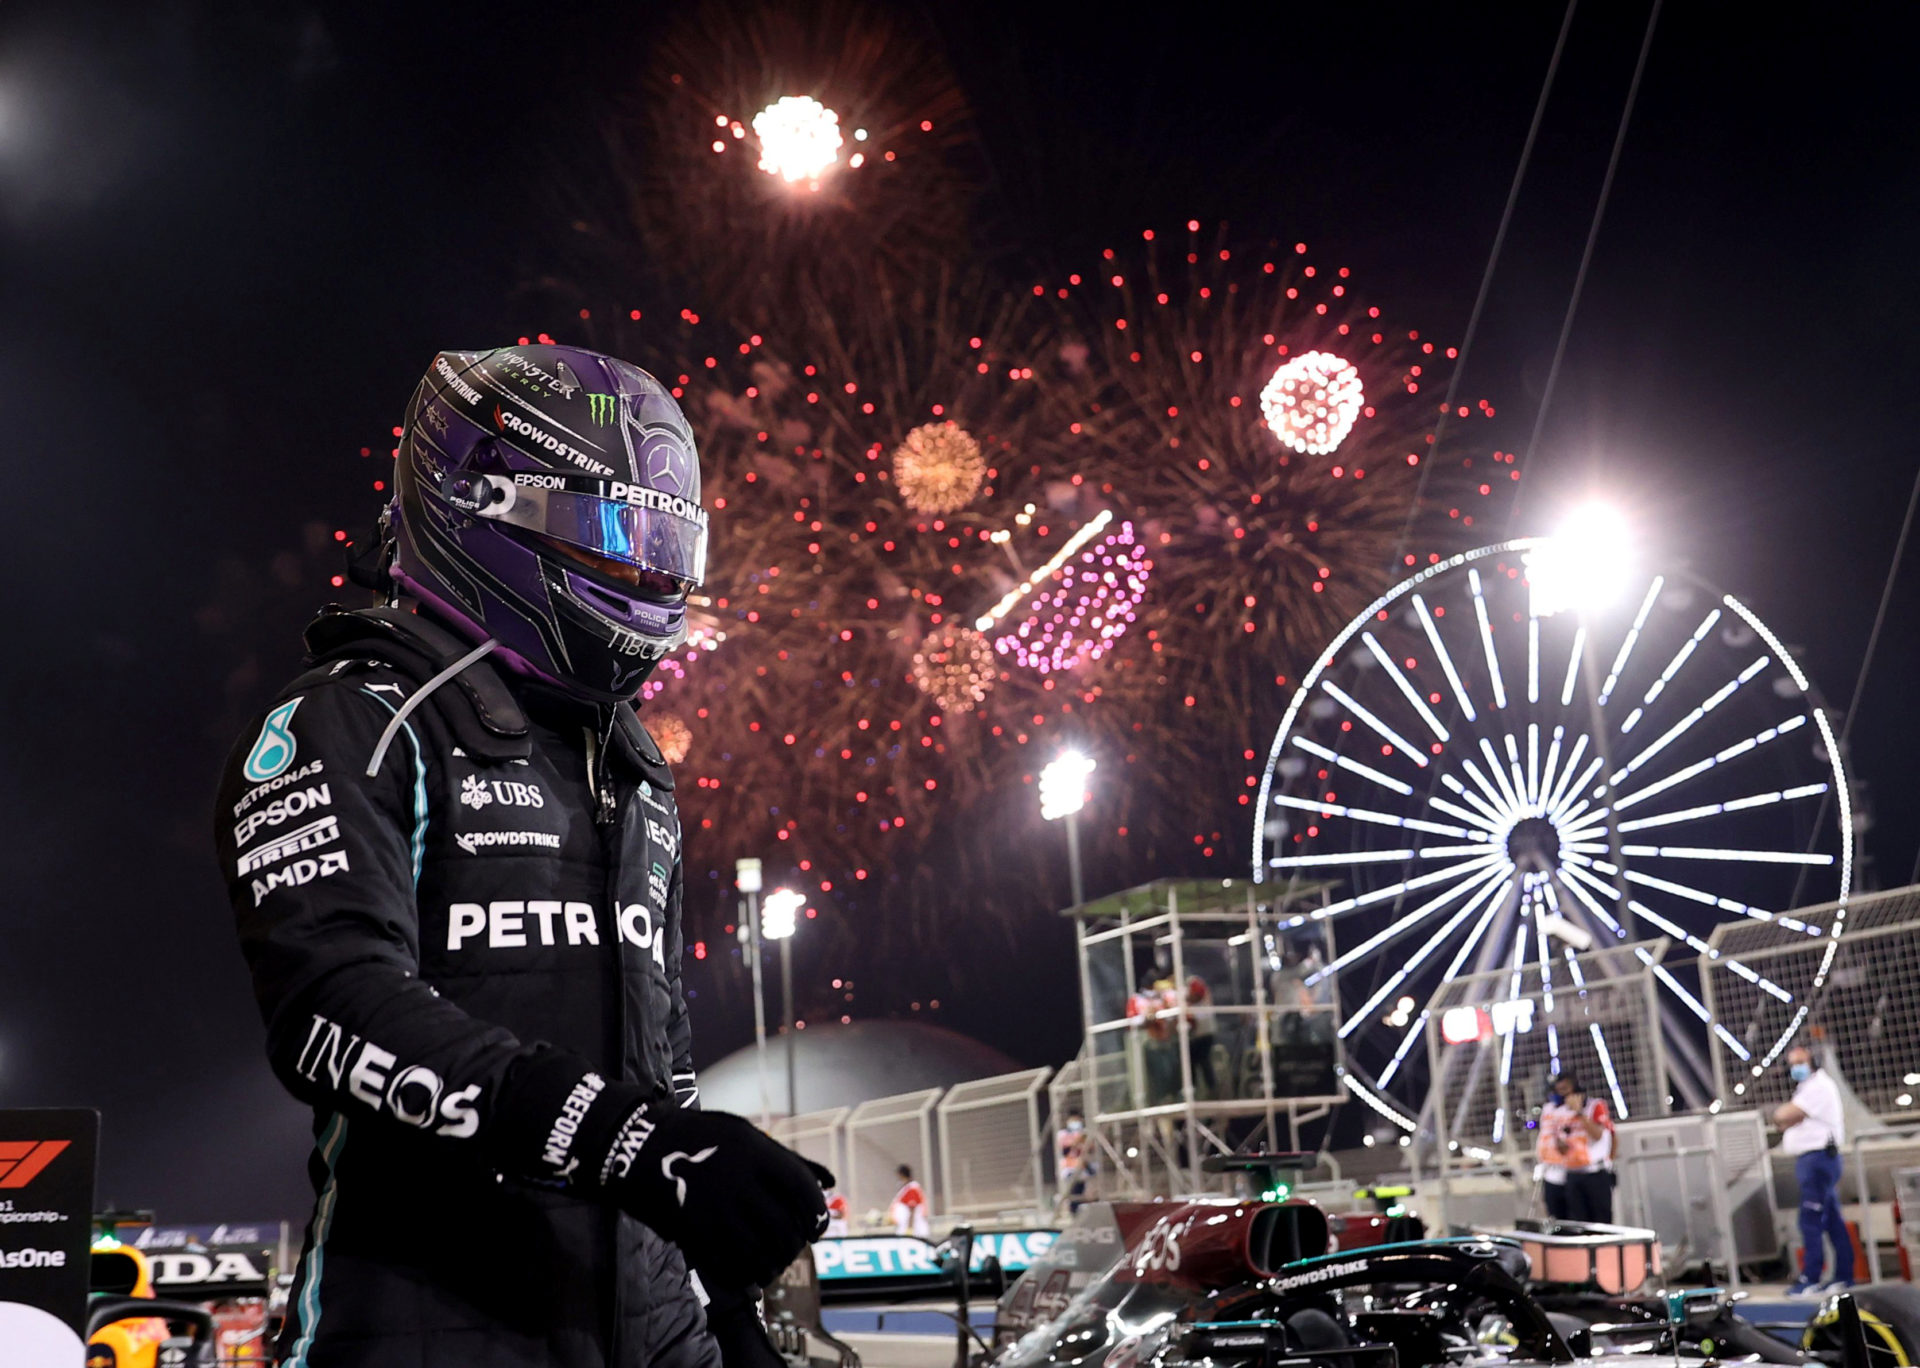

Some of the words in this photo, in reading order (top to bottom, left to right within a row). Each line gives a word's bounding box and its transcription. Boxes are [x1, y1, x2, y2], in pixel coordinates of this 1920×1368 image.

[436, 357, 483, 406] CROWDSTRIKE
[495, 362, 551, 398] ENERGY
[501, 411, 615, 476] CROWDSTRIKE
[449, 495, 480, 509] POLICE
[514, 473, 566, 490] EPSON
[634, 609, 667, 625] POLICE
[233, 759, 324, 818] PETRONAS
[491, 780, 545, 809] UBS
[233, 783, 332, 848] EPSON
[237, 815, 341, 878] PIRELLI
[463, 832, 561, 849] CROWDSTRIKE
[251, 859, 318, 908] AMD
[296, 1014, 482, 1139] INEOS
[541, 1072, 606, 1166] #REFORM
[612, 1117, 656, 1178] IWC
[1275, 1259, 1369, 1291] CROWDSTRIKE
